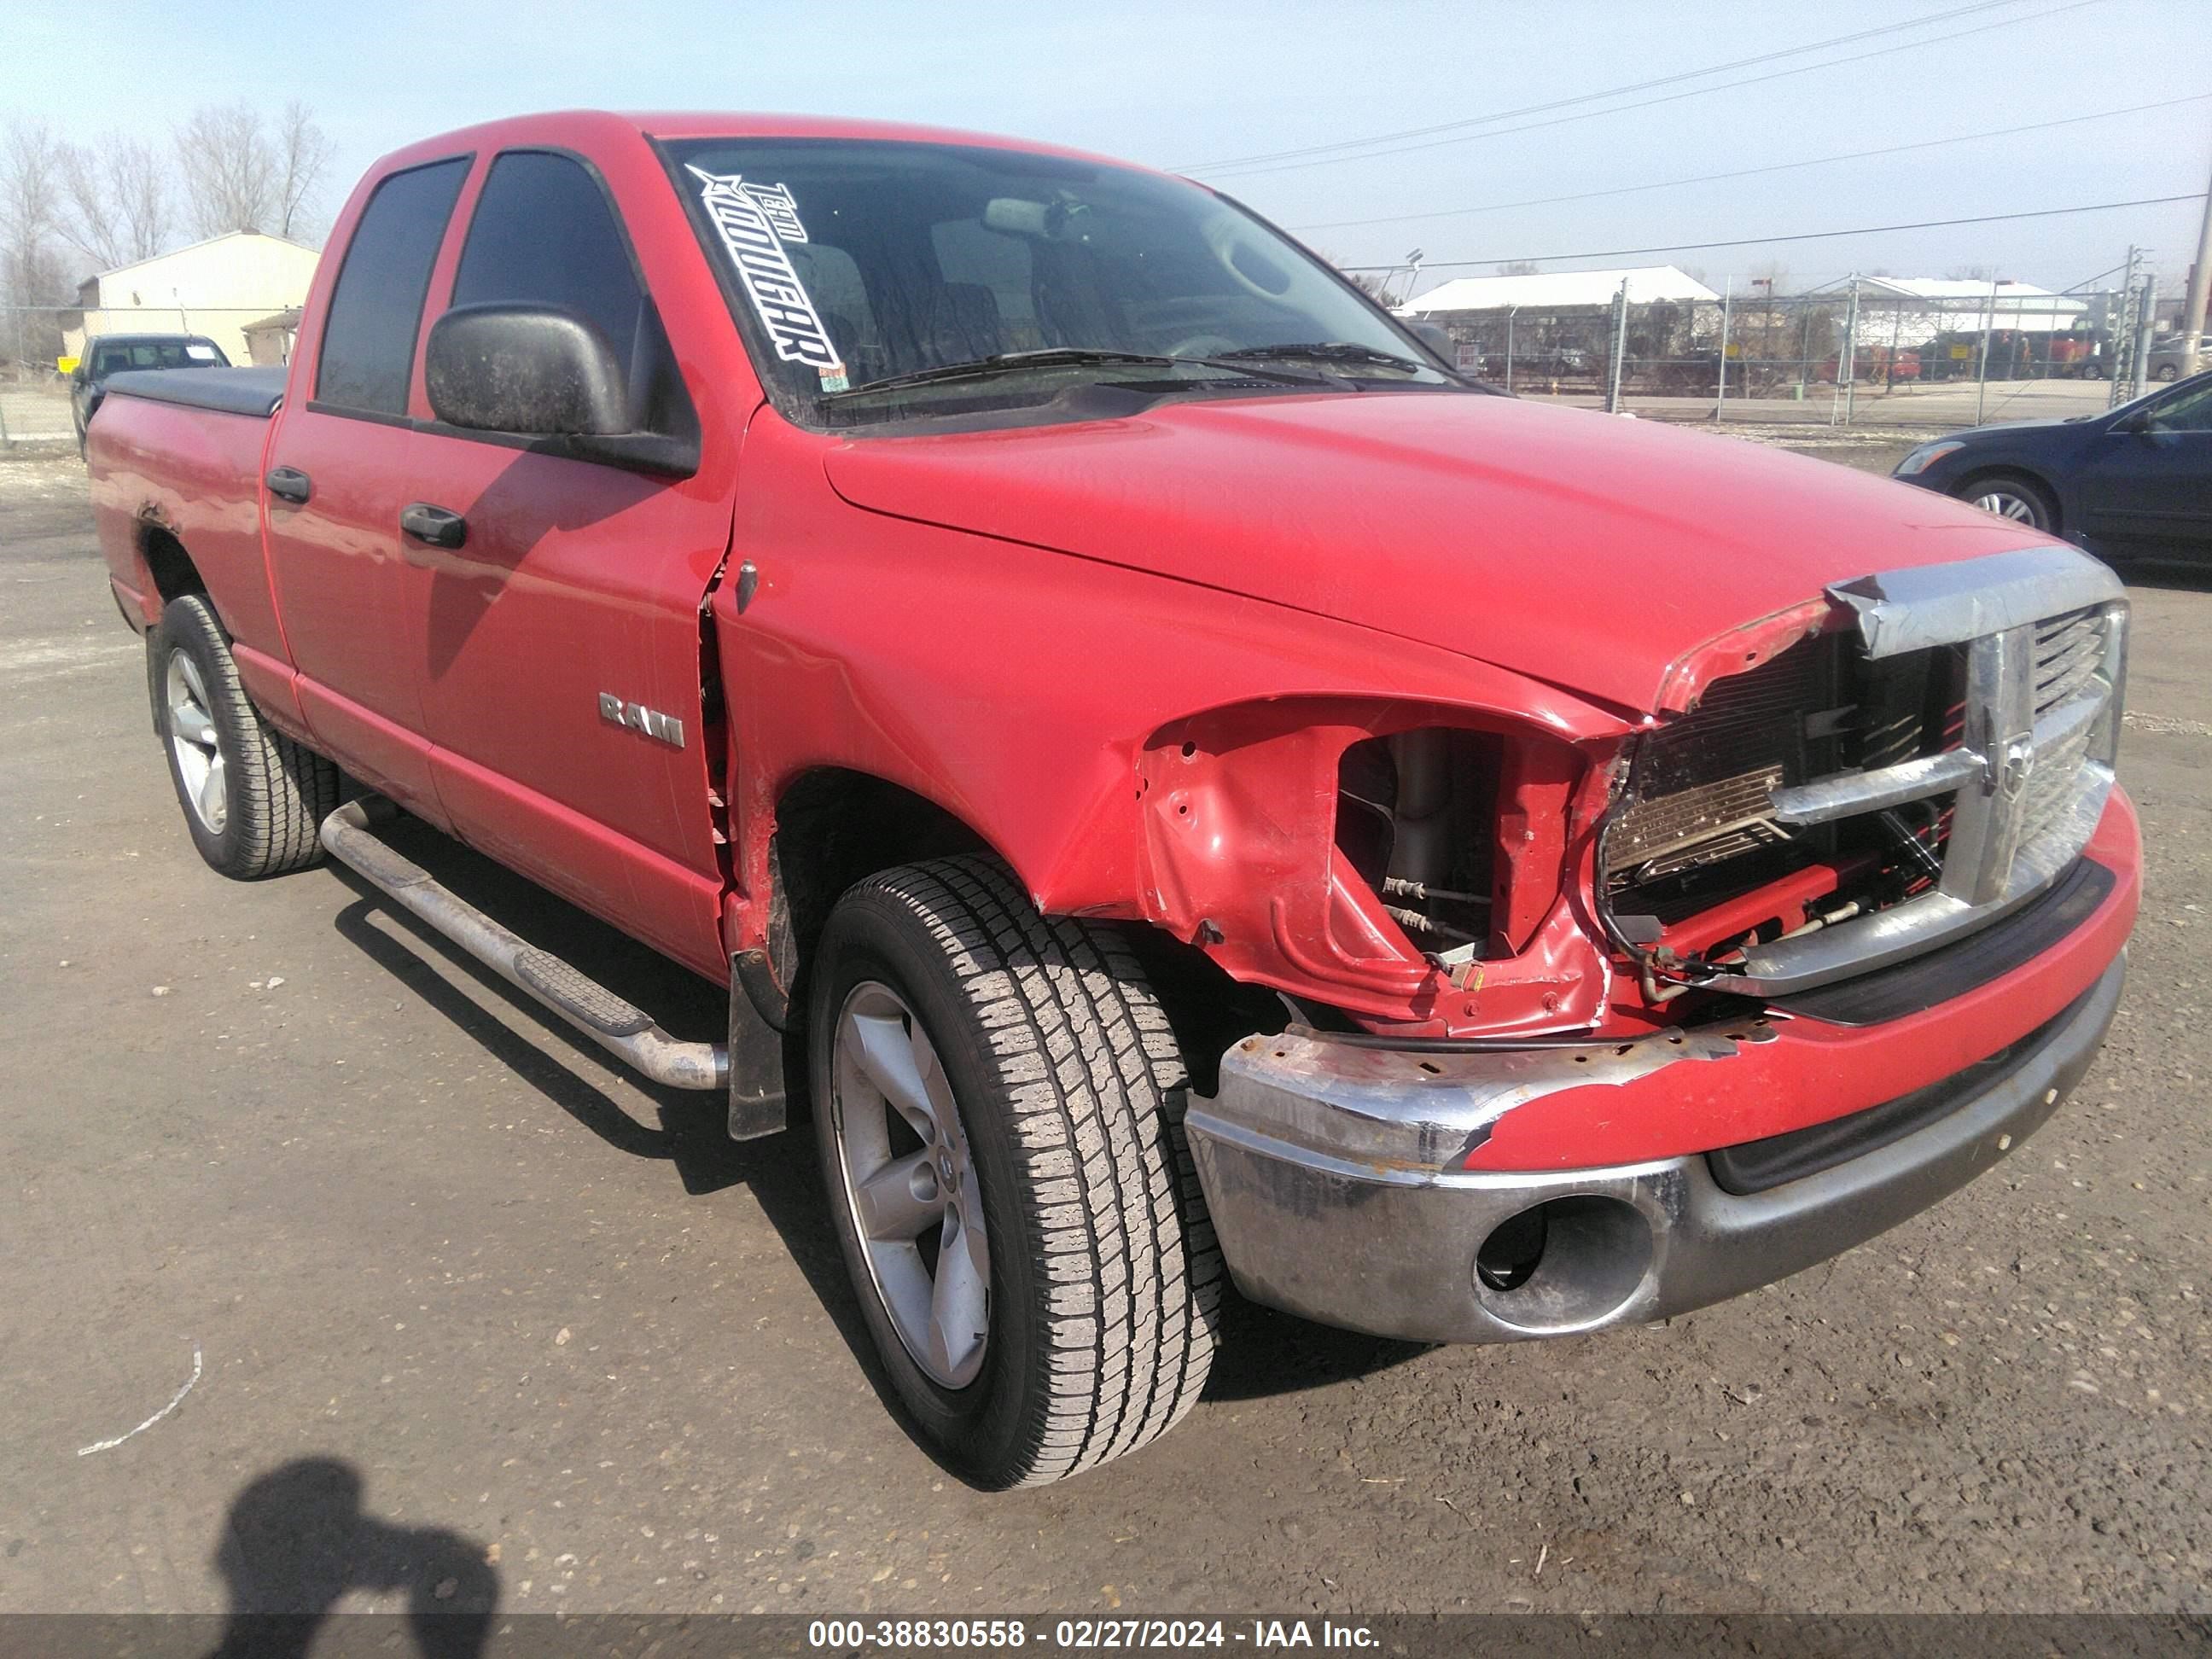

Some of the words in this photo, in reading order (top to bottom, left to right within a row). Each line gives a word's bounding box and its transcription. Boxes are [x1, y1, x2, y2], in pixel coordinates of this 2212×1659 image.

[739, 182, 808, 243] TEAM
[703, 194, 840, 370] COUGAR
[599, 692, 684, 748] RAM
